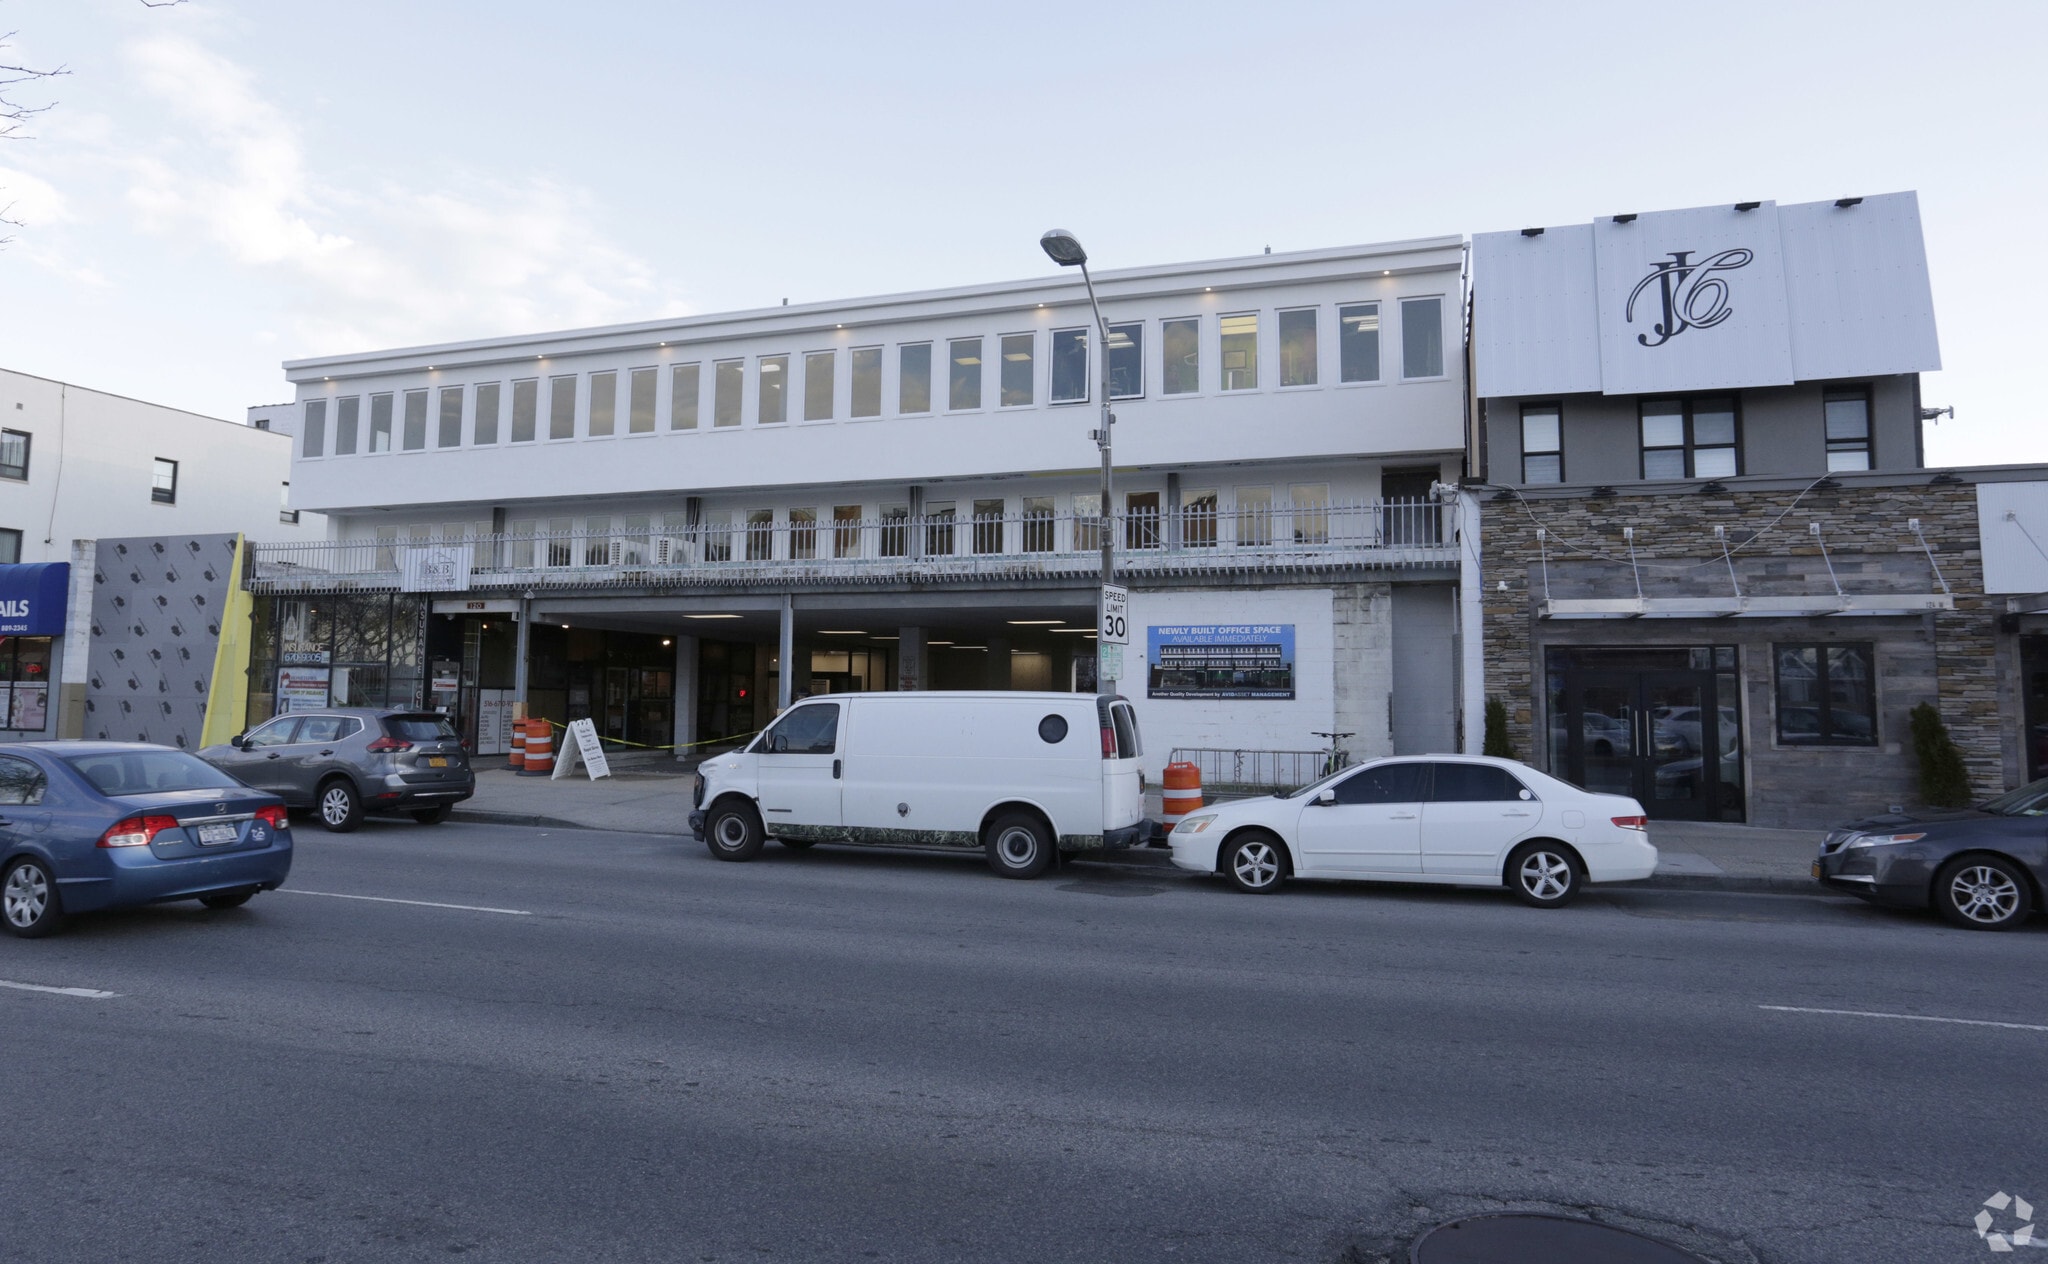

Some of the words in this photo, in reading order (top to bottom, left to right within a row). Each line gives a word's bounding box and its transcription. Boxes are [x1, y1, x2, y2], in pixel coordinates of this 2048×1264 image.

[1104, 590, 1126, 603] SPEED
[1106, 603, 1123, 613] LIMIT
[1104, 615, 1125, 637] 30
[1158, 627, 1188, 635] NEWLY
[1218, 626, 1251, 634] OFFICE
[1253, 626, 1281, 634] SPACE
[1172, 635, 1213, 643] AVAILABLE
